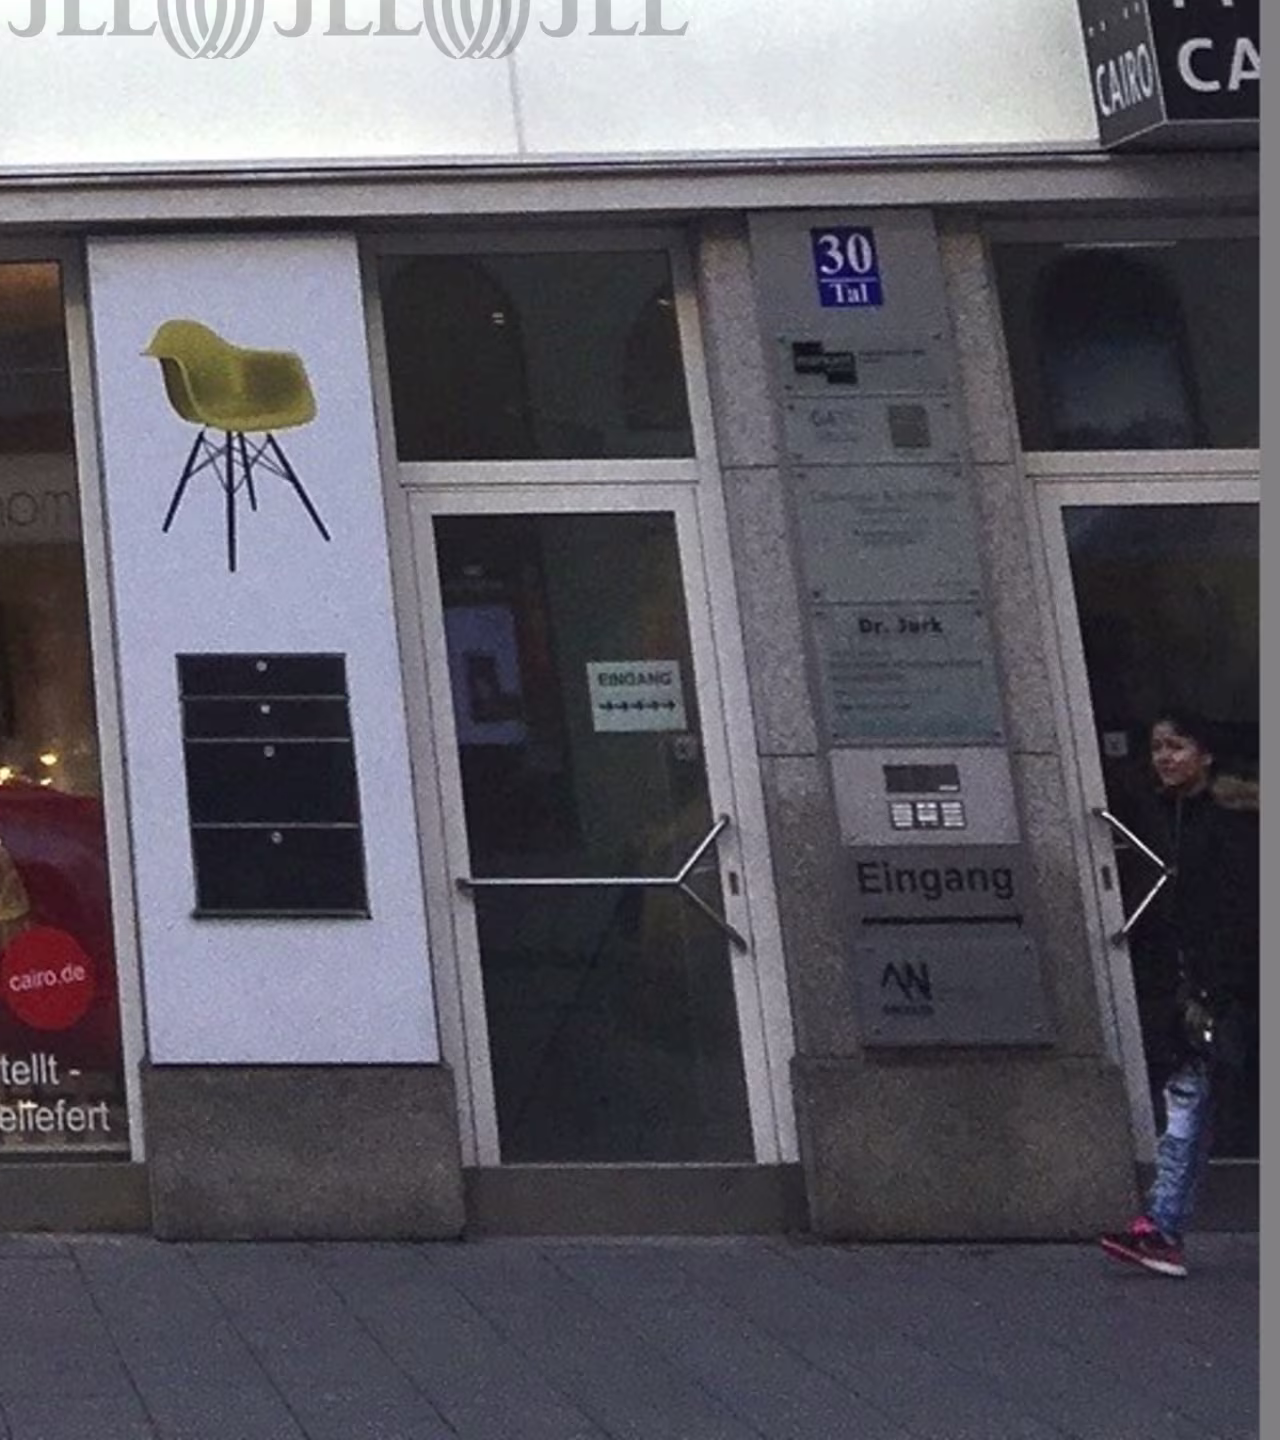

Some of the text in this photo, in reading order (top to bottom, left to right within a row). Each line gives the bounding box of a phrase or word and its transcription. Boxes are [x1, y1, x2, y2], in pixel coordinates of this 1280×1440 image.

[1096, 42, 1153, 117] CAIRO
[819, 233, 872, 275] 30
[829, 283, 867, 304] Tal
[858, 618, 889, 635] Dr.
[598, 672, 672, 687] EINGANG
[857, 862, 1014, 899] Eingang
[9, 963, 86, 992] cairo.de
